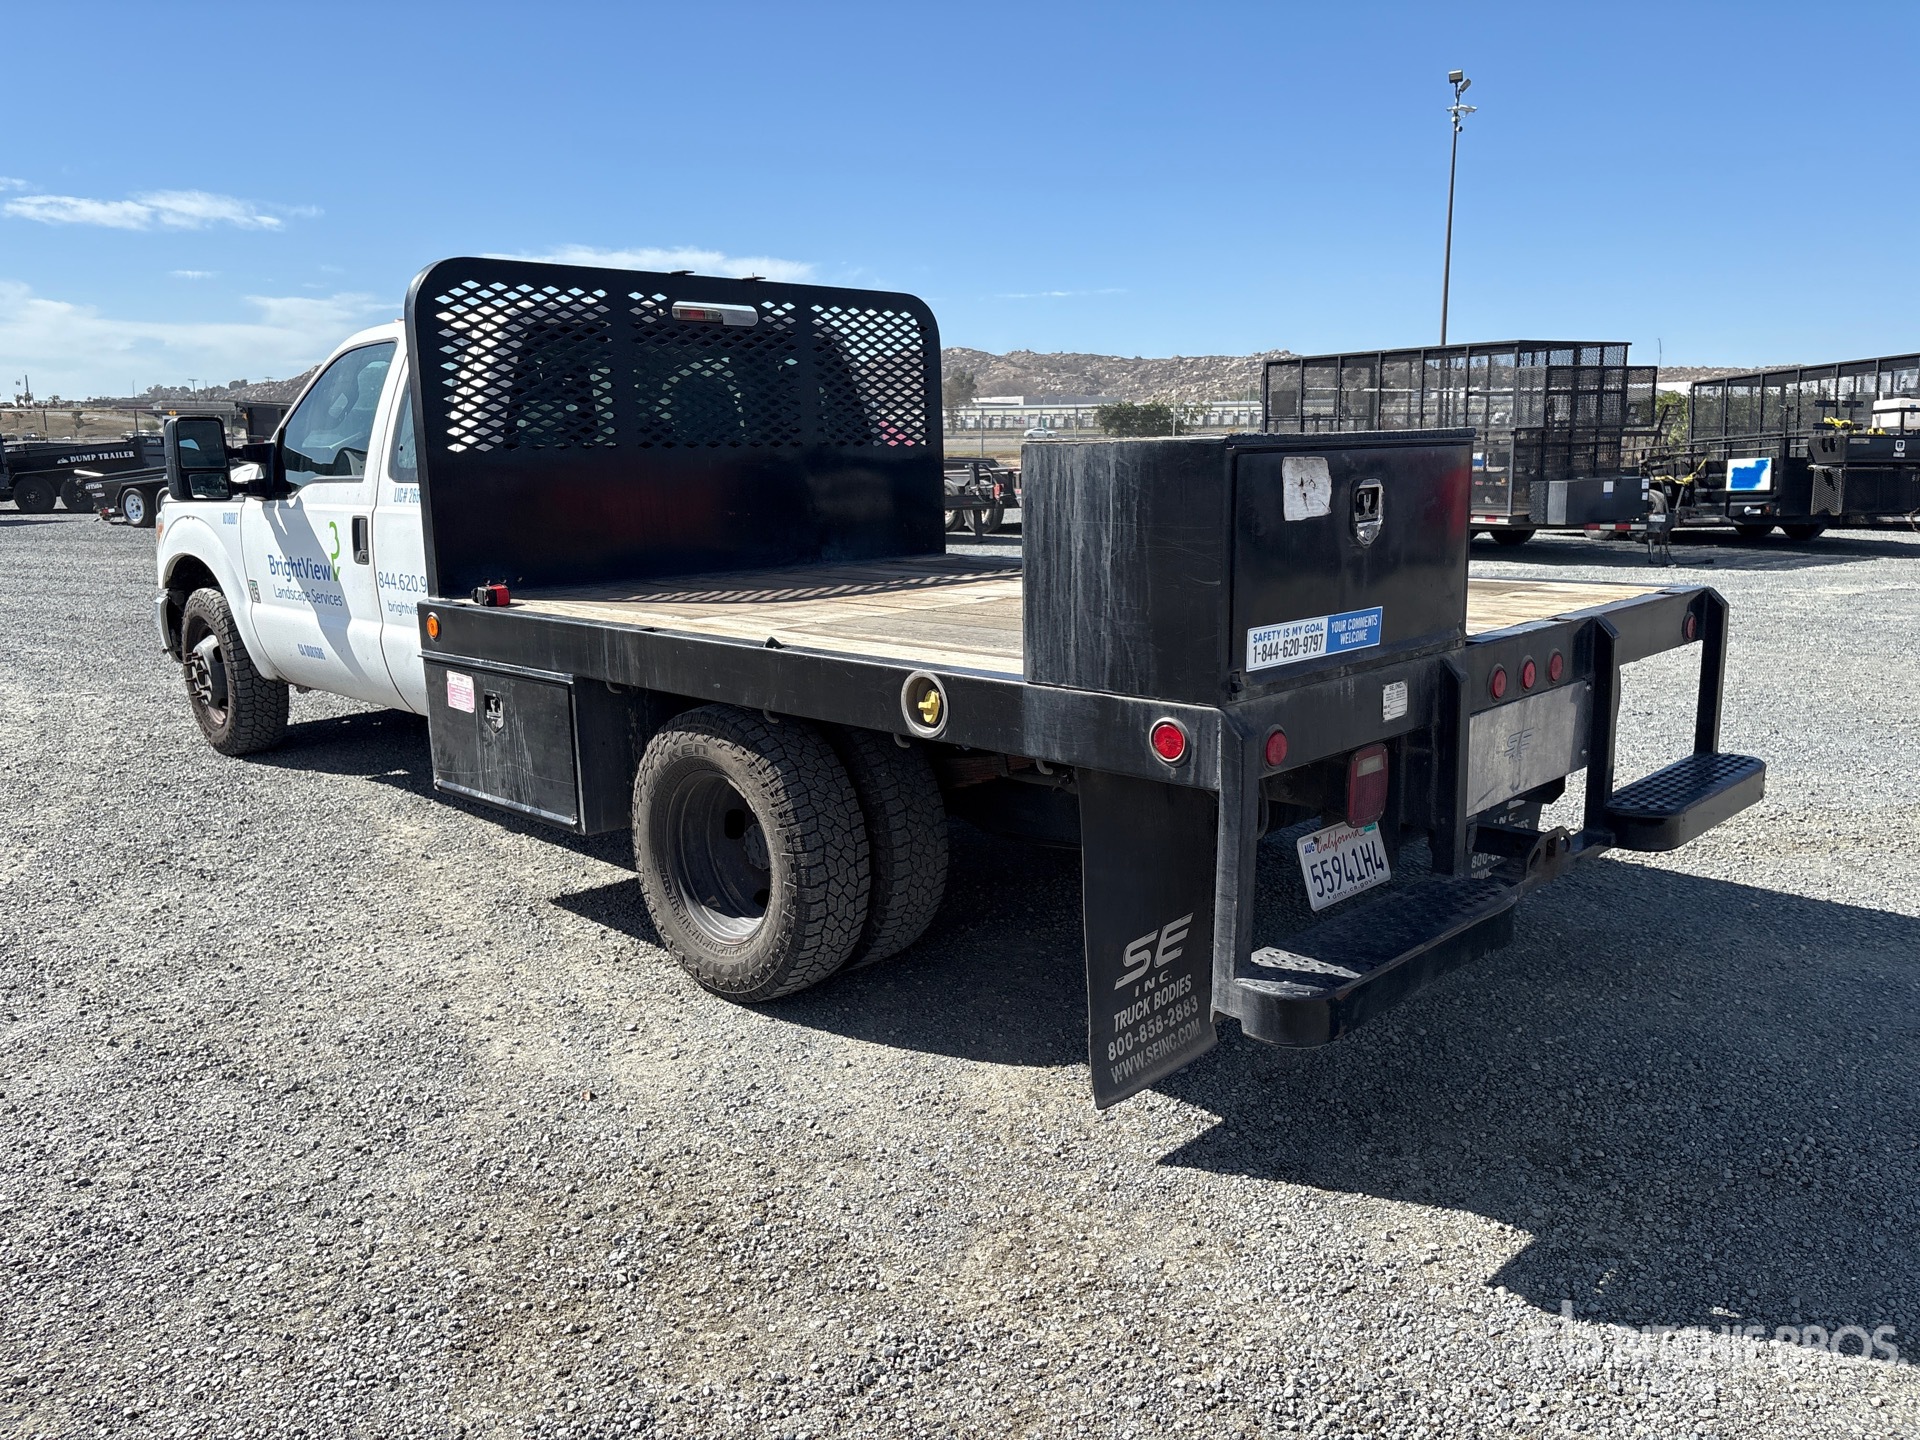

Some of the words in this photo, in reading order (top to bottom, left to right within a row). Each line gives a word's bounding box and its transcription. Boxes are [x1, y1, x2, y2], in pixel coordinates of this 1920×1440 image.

[70, 453, 96, 463] DUMP
[98, 450, 135, 461] TRAILER
[267, 554, 331, 583] BrightView
[378, 571, 427, 593] 844.620.9
[273, 584, 311, 605] Landscape
[311, 588, 343, 607] Services
[1253, 630, 1281, 644] SAFETY
[1283, 627, 1290, 637] IS
[1292, 625, 1303, 637] MY
[1304, 622, 1324, 633] GOAL
[1331, 620, 1347, 634] YOUR
[1348, 614, 1378, 630] COMMENTS
[1253, 633, 1324, 664] 1-844-620-9797
[1340, 631, 1367, 645] WELCOME
[1304, 842, 1315, 855] AUG
[1316, 828, 1365, 854] California
[1309, 840, 1385, 898] 55941H4
[1332, 879, 1373, 900] dmv.ca.gov
[1114, 912, 1194, 990] SE
[1134, 970, 1172, 997] INC.
[1114, 996, 1151, 1033] TRUCK
[1154, 974, 1192, 1011] BODIES
[1108, 994, 1199, 1061] 800-858-2883
[1111, 1017, 1202, 1085] WWW.SEINC.COM
